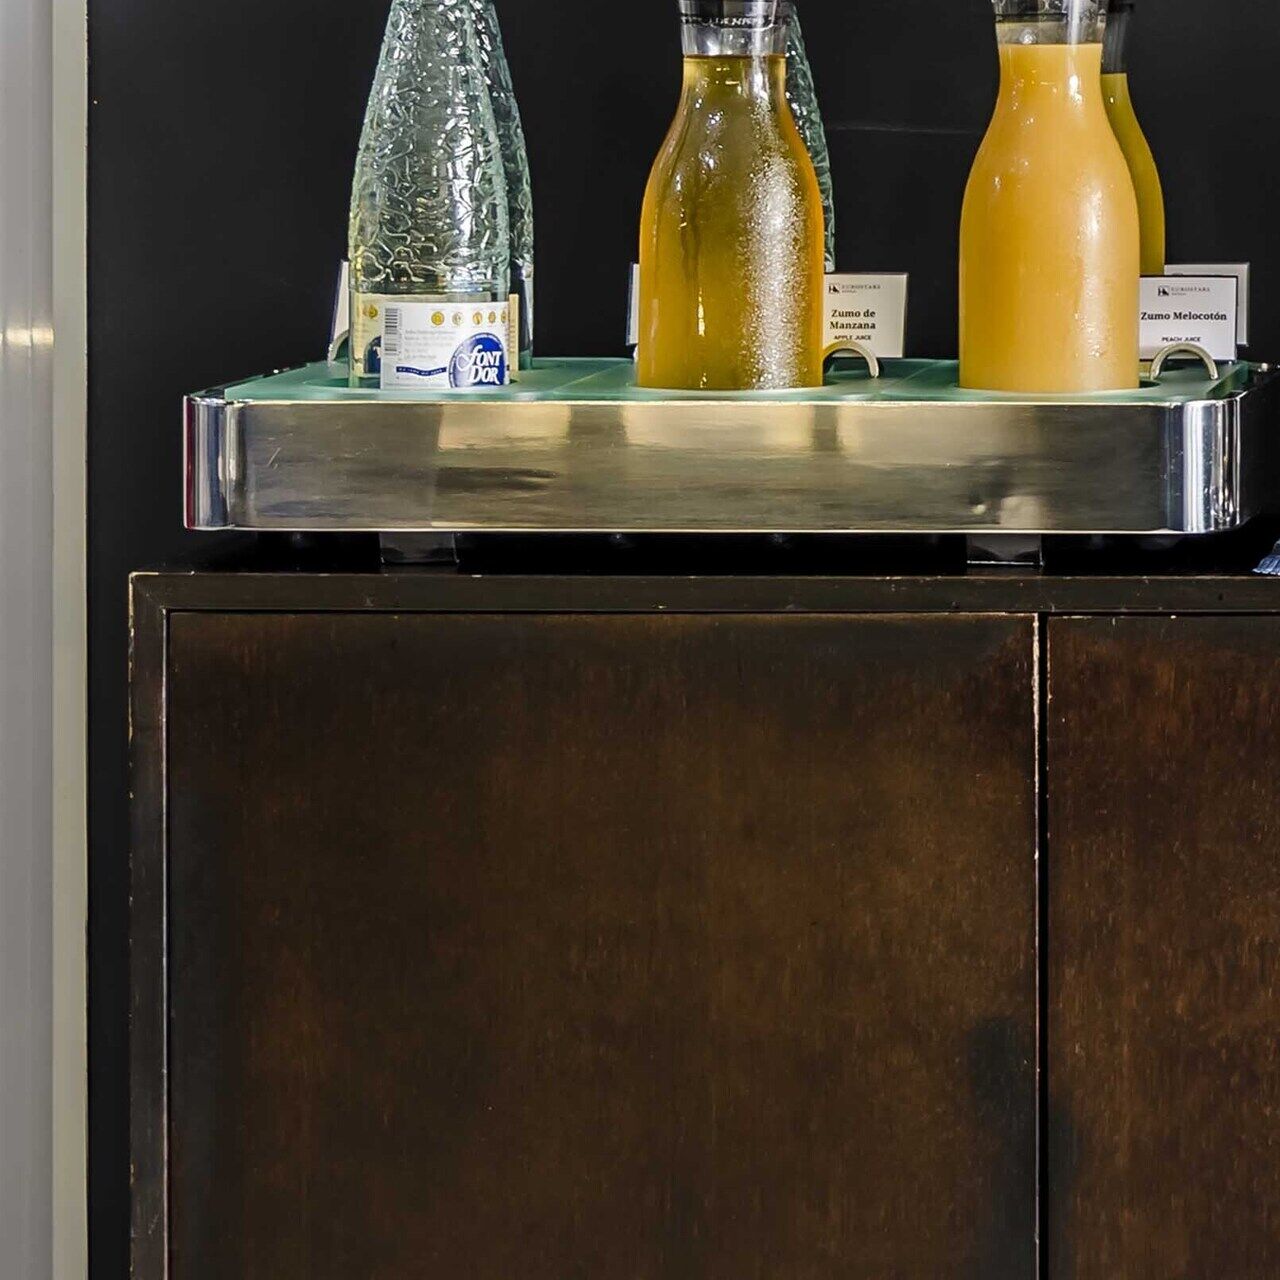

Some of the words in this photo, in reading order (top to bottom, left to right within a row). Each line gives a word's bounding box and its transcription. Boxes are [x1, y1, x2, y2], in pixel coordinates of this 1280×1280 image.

[831, 309, 860, 318] Zumo
[863, 309, 876, 317] de
[1140, 312, 1170, 320] Zumo
[1173, 311, 1227, 320] Melocotón
[829, 321, 876, 329] Manzana
